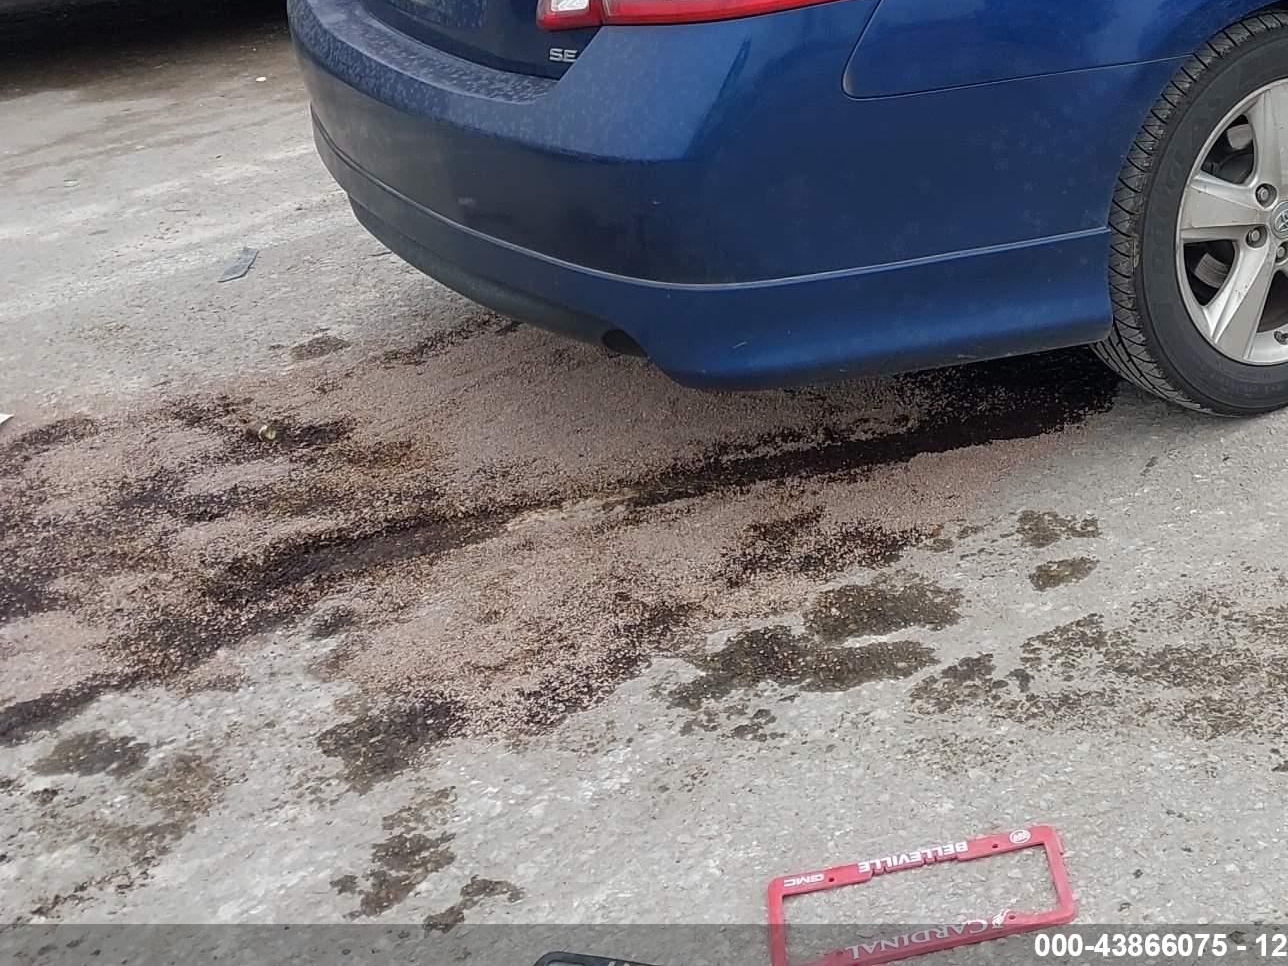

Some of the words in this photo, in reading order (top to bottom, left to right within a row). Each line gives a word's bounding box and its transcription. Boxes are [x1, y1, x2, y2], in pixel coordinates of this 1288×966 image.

[549, 48, 578, 63] SE
[857, 841, 969, 873] BELLEVILLE
[783, 873, 825, 888] GMC
[845, 918, 989, 960] CARDINAL
